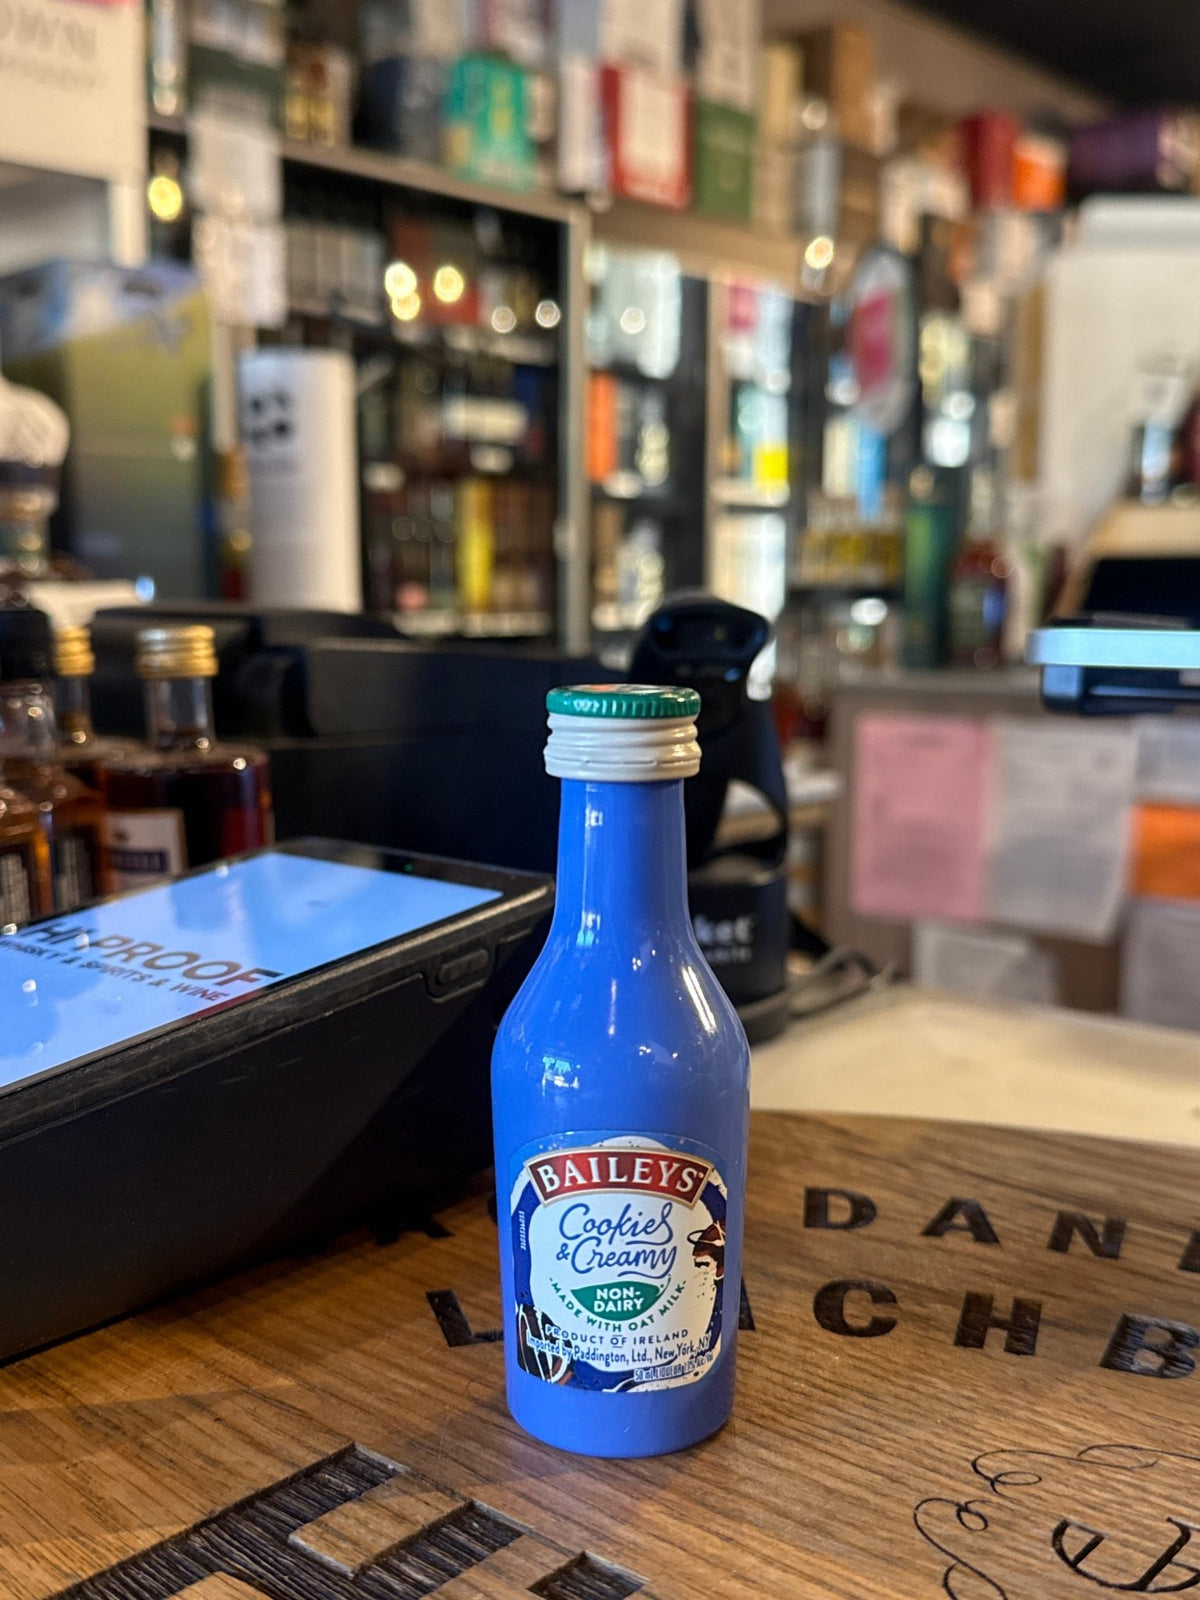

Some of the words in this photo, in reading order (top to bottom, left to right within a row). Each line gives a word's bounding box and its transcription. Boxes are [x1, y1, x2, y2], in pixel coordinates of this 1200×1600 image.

[170, 982, 231, 1002] WINE
[537, 1157, 699, 1193] BAILEYS
[559, 1202, 674, 1246] Cookies
[556, 1242, 570, 1261] &
[571, 1236, 678, 1280] Creamy
[594, 1298, 644, 1313] DAIRY
[596, 1286, 641, 1300] NON-
[551, 1282, 583, 1318] MADE
[586, 1315, 622, 1333] WITH
[628, 1314, 656, 1332] OAT
[546, 1325, 605, 1345] PRODUCT
[610, 1336, 627, 1346] OF
[633, 1328, 689, 1345] IRELAND
[562, 1342, 572, 1362] by
[573, 1344, 629, 1368] Paddington,
[655, 1346, 675, 1361] New
